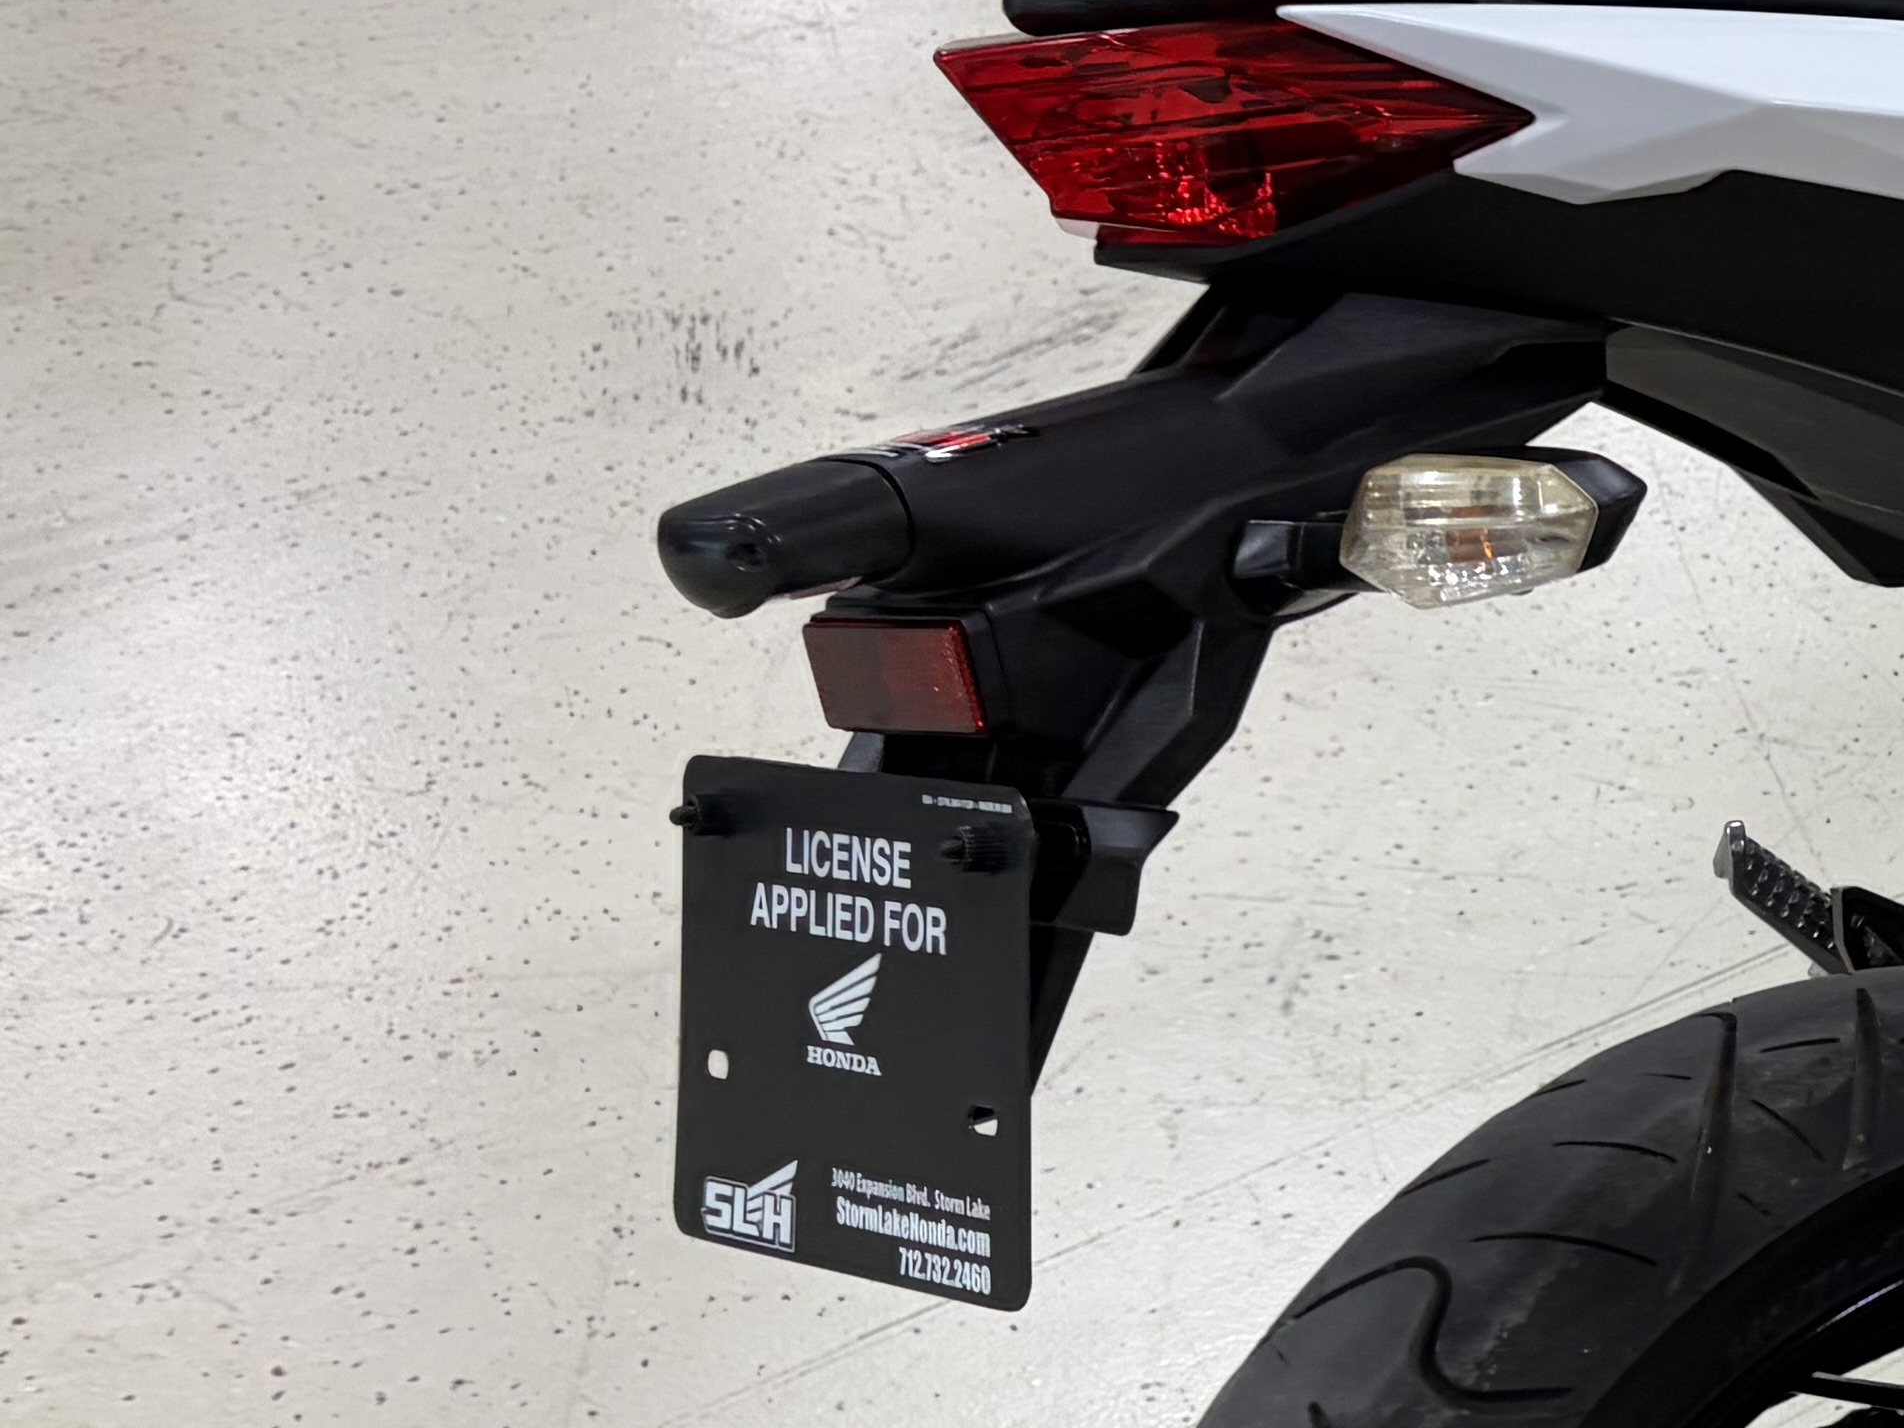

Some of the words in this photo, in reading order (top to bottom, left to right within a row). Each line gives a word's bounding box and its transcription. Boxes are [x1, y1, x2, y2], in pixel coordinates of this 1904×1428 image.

[785, 826, 912, 890] LICENSE
[750, 881, 875, 944] APPLIED
[882, 899, 947, 956] FOR
[806, 1044, 882, 1076] HONDA
[703, 1178, 795, 1250] SLH
[836, 1195, 992, 1258] StormLakeHonda.com
[856, 1172, 905, 1203] Expansion
[905, 1182, 931, 1207] Blvd.
[933, 1189, 965, 1214] Storm
[965, 1196, 992, 1221] Lake
[898, 1246, 992, 1296] 712.732.2460
